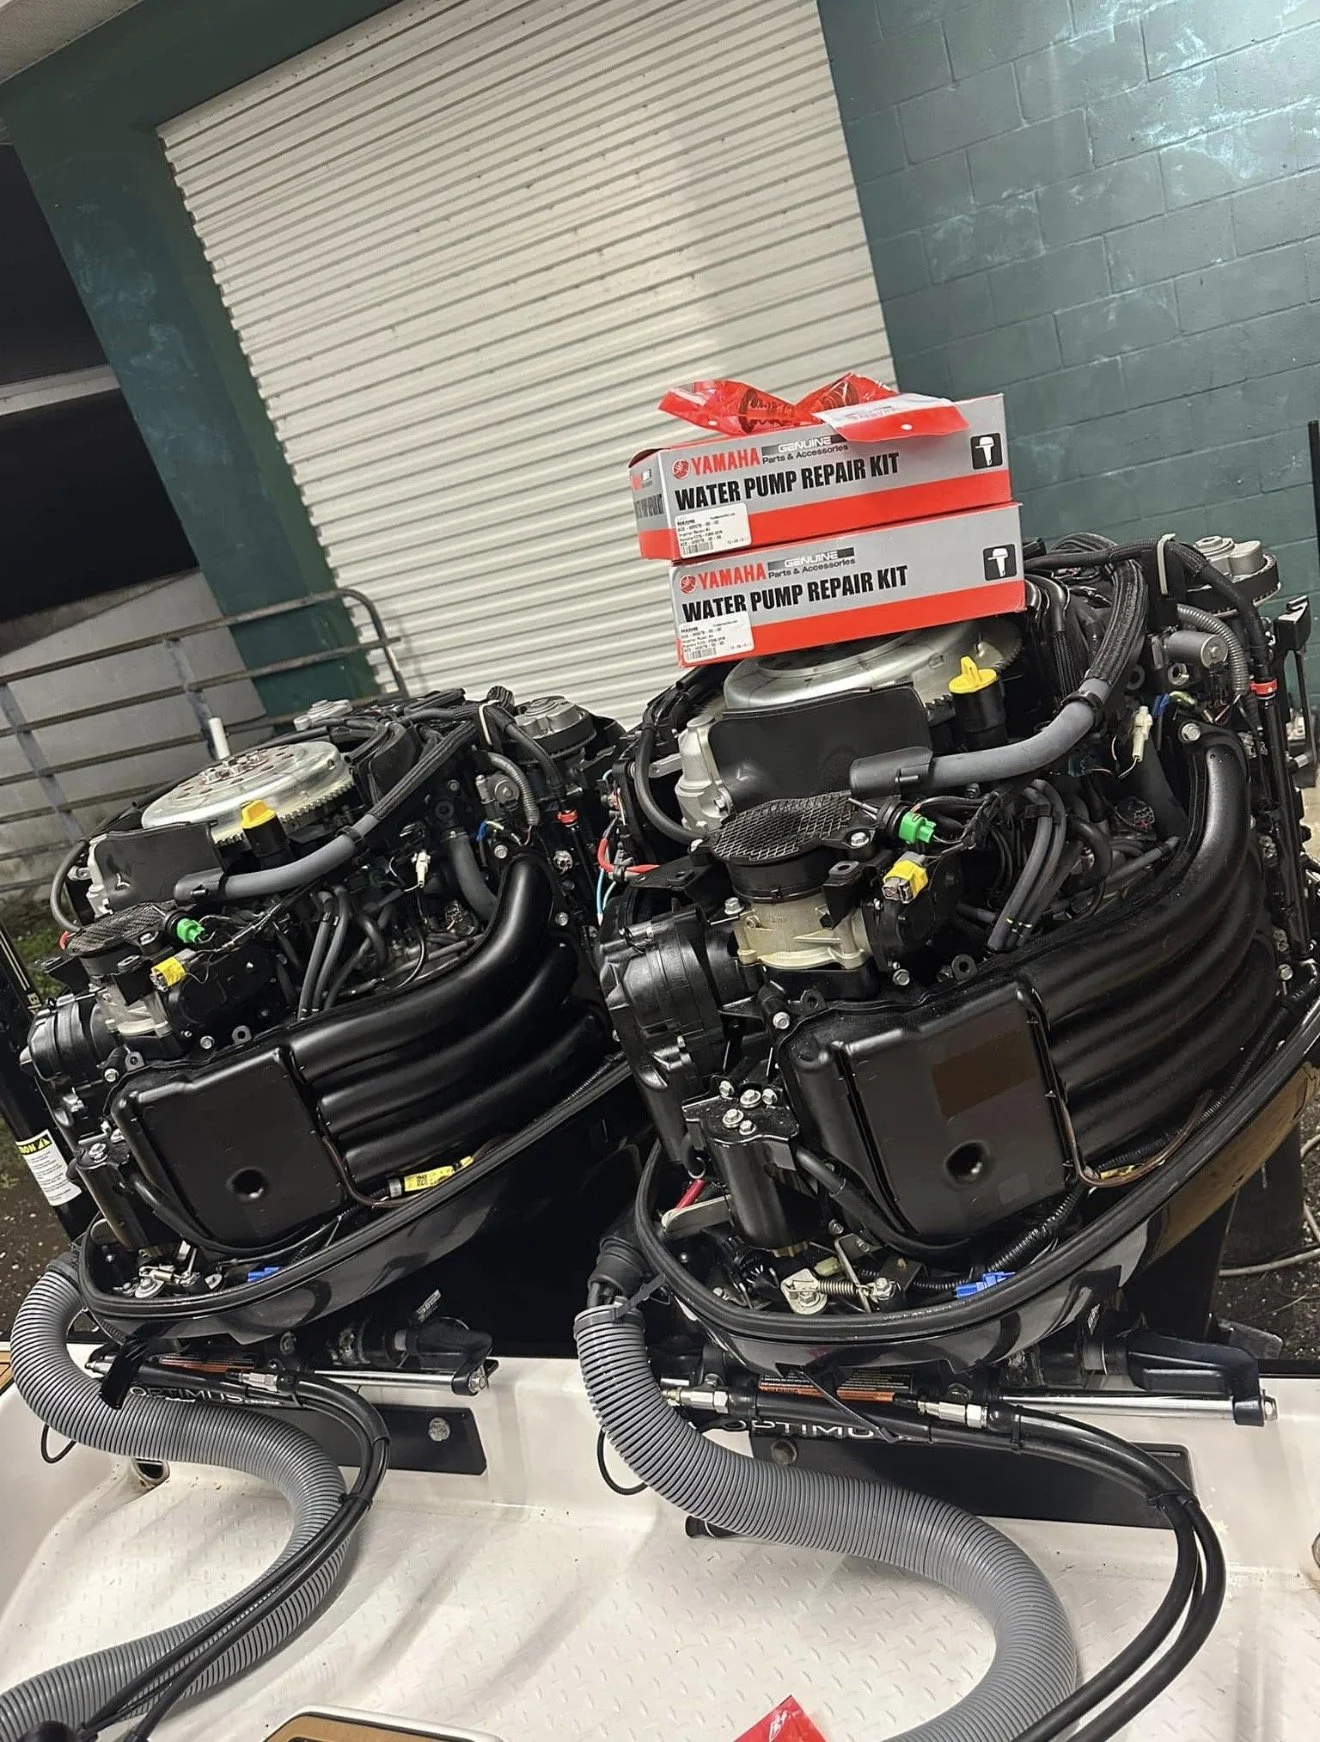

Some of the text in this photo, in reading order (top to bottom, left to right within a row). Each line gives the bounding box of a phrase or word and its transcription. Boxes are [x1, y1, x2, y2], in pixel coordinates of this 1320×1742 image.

[762, 454, 786, 464] Parts
[796, 444, 849, 459] Accessories
[778, 435, 832, 453] GENUINE
[691, 447, 761, 476] YAMAHA
[675, 480, 741, 511] WATER
[744, 470, 797, 499] PUMP
[801, 458, 867, 490] REPAIR
[869, 452, 900, 477] KIT
[768, 570, 792, 579] Parts
[802, 559, 856, 574] Accessories
[784, 550, 839, 568] GENUINE
[698, 562, 767, 590] YAMAHA
[682, 565, 908, 622] WATER PUMP REPAIR KIT
[723, 1419, 875, 1439] OPTIMU
